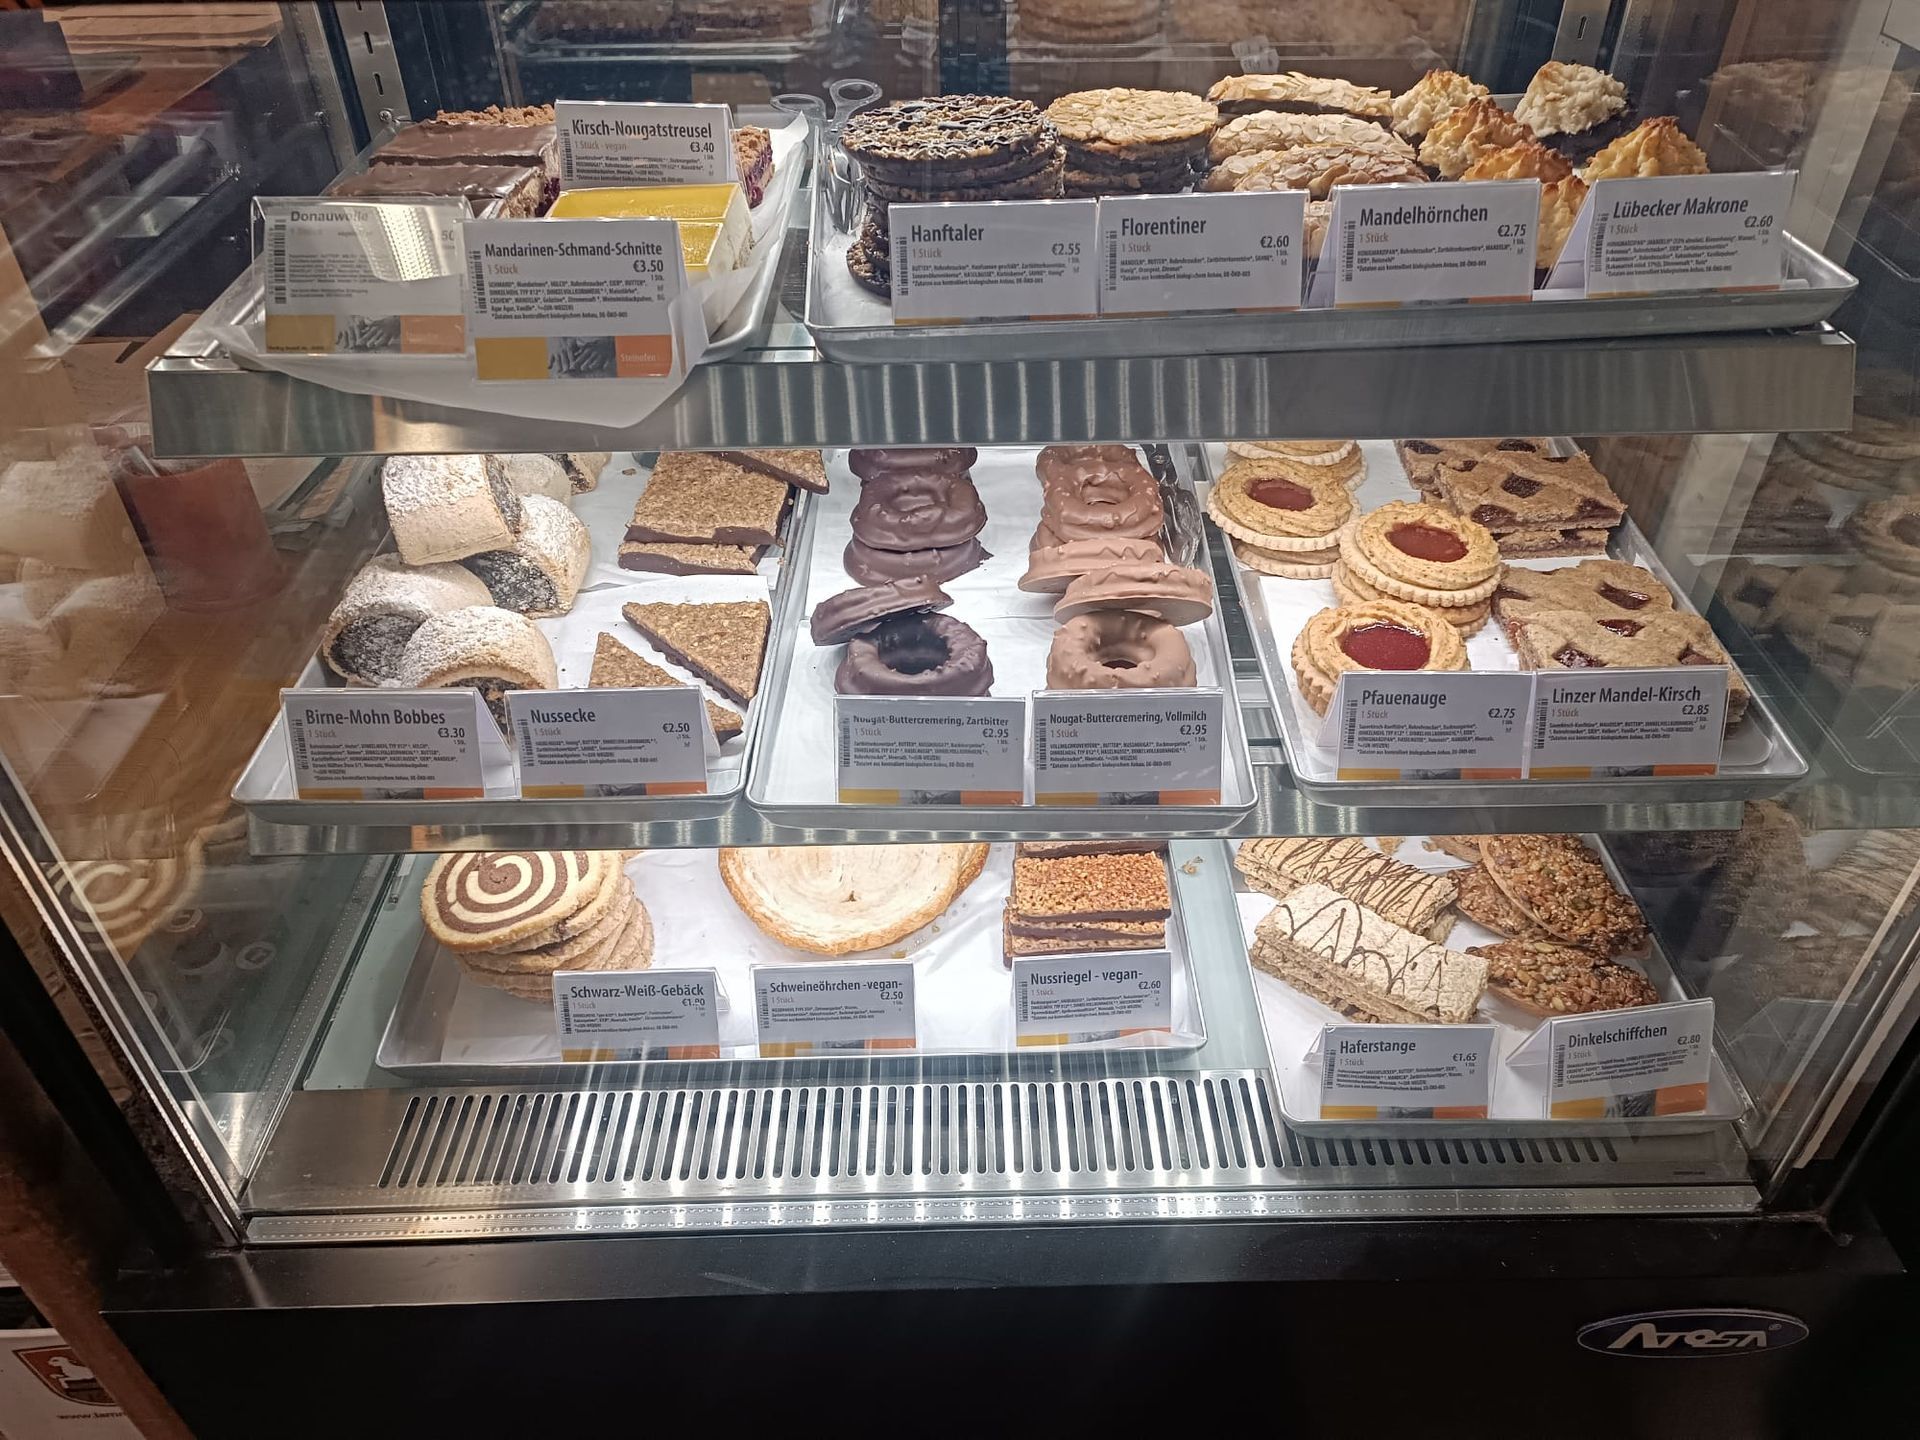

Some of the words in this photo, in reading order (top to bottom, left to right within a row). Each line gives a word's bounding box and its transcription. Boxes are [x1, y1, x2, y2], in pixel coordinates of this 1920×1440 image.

[572, 119, 712, 141] Kirsch-Nougatstreusel
[605, 143, 627, 152] vegan
[690, 141, 714, 153] €3.40
[1613, 200, 1681, 219] Lübecker
[1683, 197, 1748, 215] Makrone
[1360, 205, 1488, 227] Mandelhörnchen
[1744, 215, 1773, 228] €2.60
[1121, 216, 1206, 236] Florentiner
[1497, 224, 1526, 237] €2.75
[911, 224, 984, 242] Hanftaler
[1365, 232, 1389, 243] Stück
[1260, 235, 1289, 248] €2.60
[484, 241, 663, 258] Mandarinen-Schmand-Schnitte
[1052, 243, 1081, 256] €2.55
[633, 260, 664, 273] €3.50
[1362, 690, 1447, 709] Pfauenauge
[1552, 688, 1596, 703] Linzer
[1599, 686, 1701, 703] Mandel-Kirsch
[530, 708, 596, 723] Nussecke
[1488, 708, 1516, 718] €2.75
[1682, 704, 1709, 715] €2.85
[305, 709, 390, 724] Birne-Mohn
[395, 709, 445, 724] Bobbes
[853, 715, 964, 726] Nougat-Buttercremering,
[966, 716, 1009, 726] Zartbitter
[1050, 712, 1163, 726] Nougat-Buttercremering,
[1165, 711, 1207, 722] Vollmilch
[438, 727, 465, 738] €3.30
[662, 723, 690, 733] €2.50
[982, 728, 1009, 738] €2.95
[1180, 724, 1207, 735] €2.95
[1030, 970, 1092, 986] Nussriegel
[570, 984, 704, 999] Schwarz-Weiß-Gebäck
[770, 979, 860, 993] Schweineöhrchen
[862, 980, 903, 992] -vegan-
[1138, 980, 1161, 990] €2.60
[880, 991, 903, 1000] €2.50
[1568, 1025, 1668, 1048] Dinkelschiffchen
[1677, 1034, 1700, 1046] €2.80
[1340, 1040, 1416, 1054] Haferstange
[1453, 1053, 1477, 1062] €1.65
